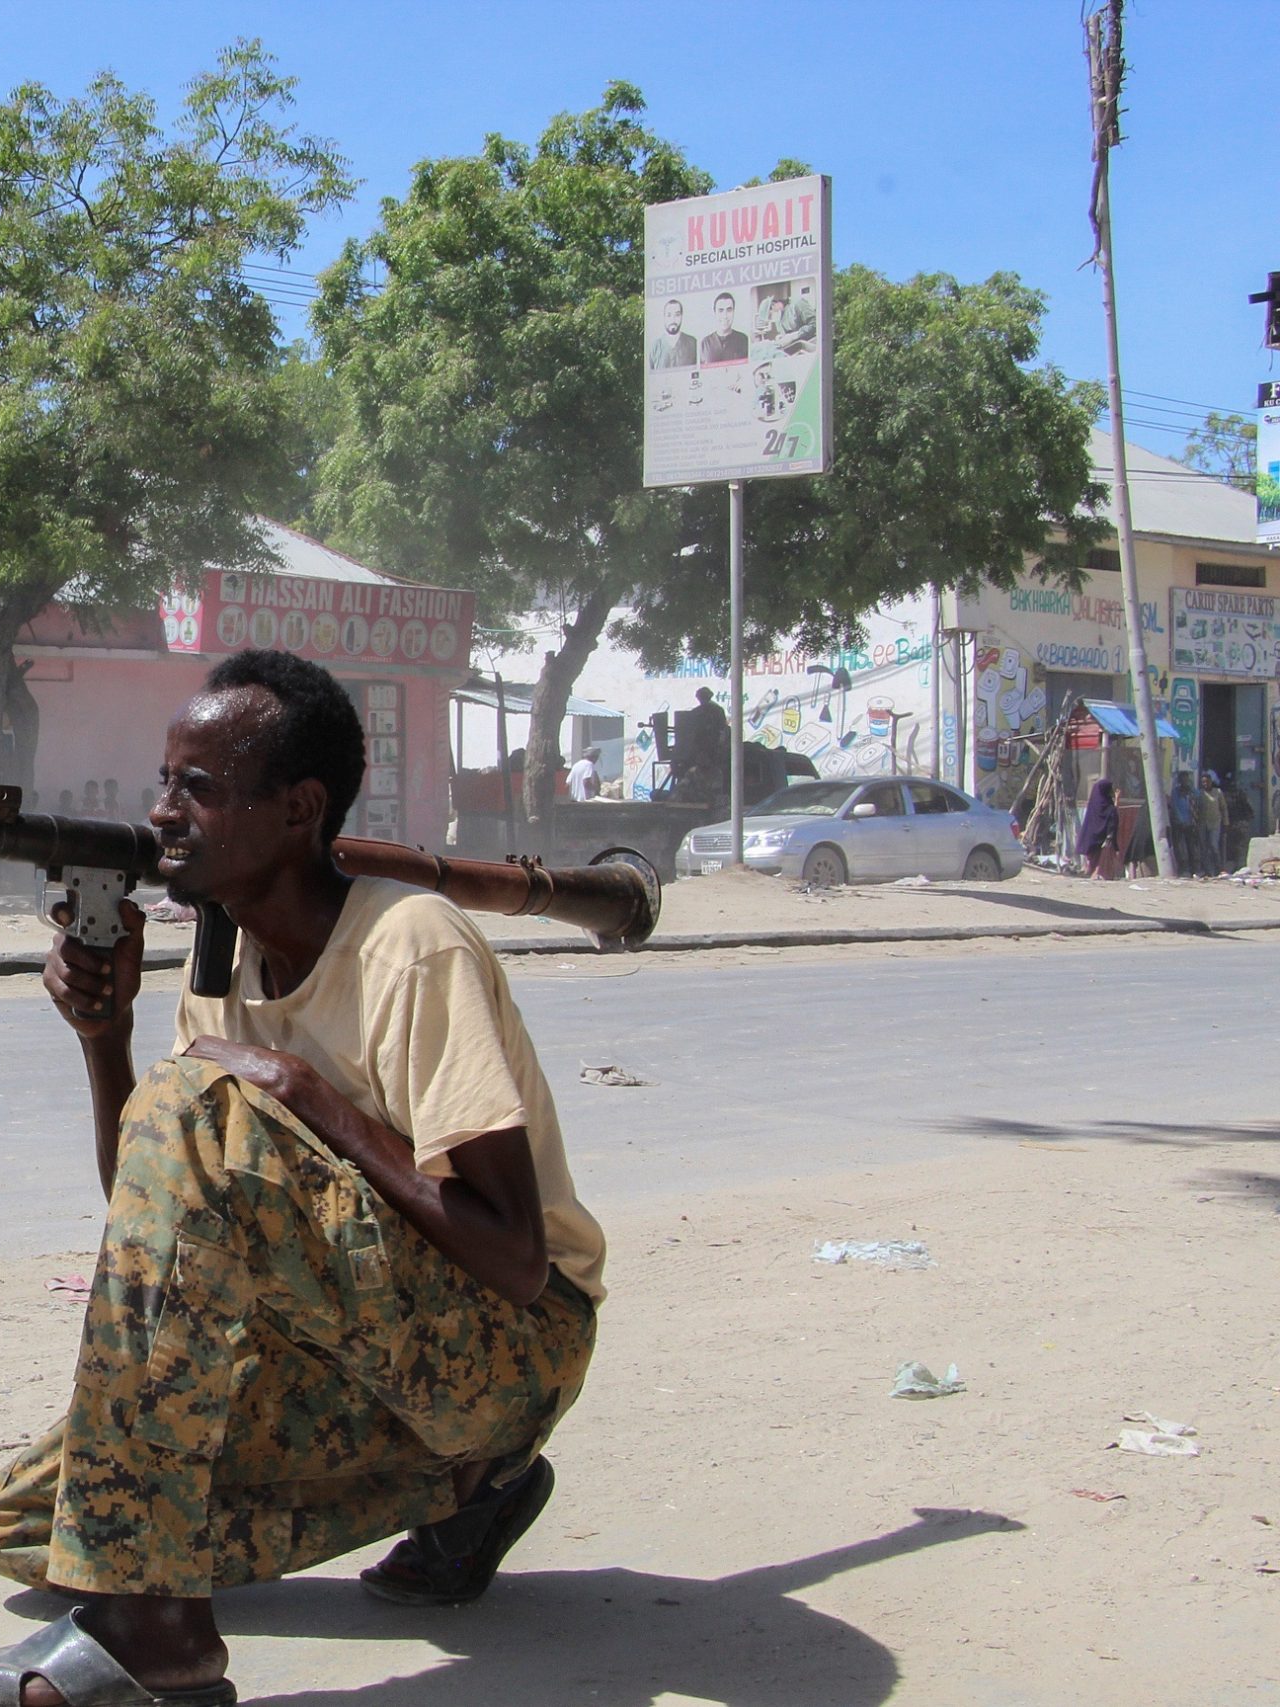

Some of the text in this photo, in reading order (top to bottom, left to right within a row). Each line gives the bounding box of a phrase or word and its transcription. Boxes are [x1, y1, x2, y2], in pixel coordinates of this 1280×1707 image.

[687, 194, 814, 252] KUWAIT
[685, 234, 817, 267] SPECIALIST HOSPITAL
[651, 255, 813, 297] ISBITALKA KUWEYT
[250, 577, 463, 622] HASSAN ALI FASHION
[1217, 594, 1246, 614] SPARE
[1247, 597, 1275, 618] PARTS
